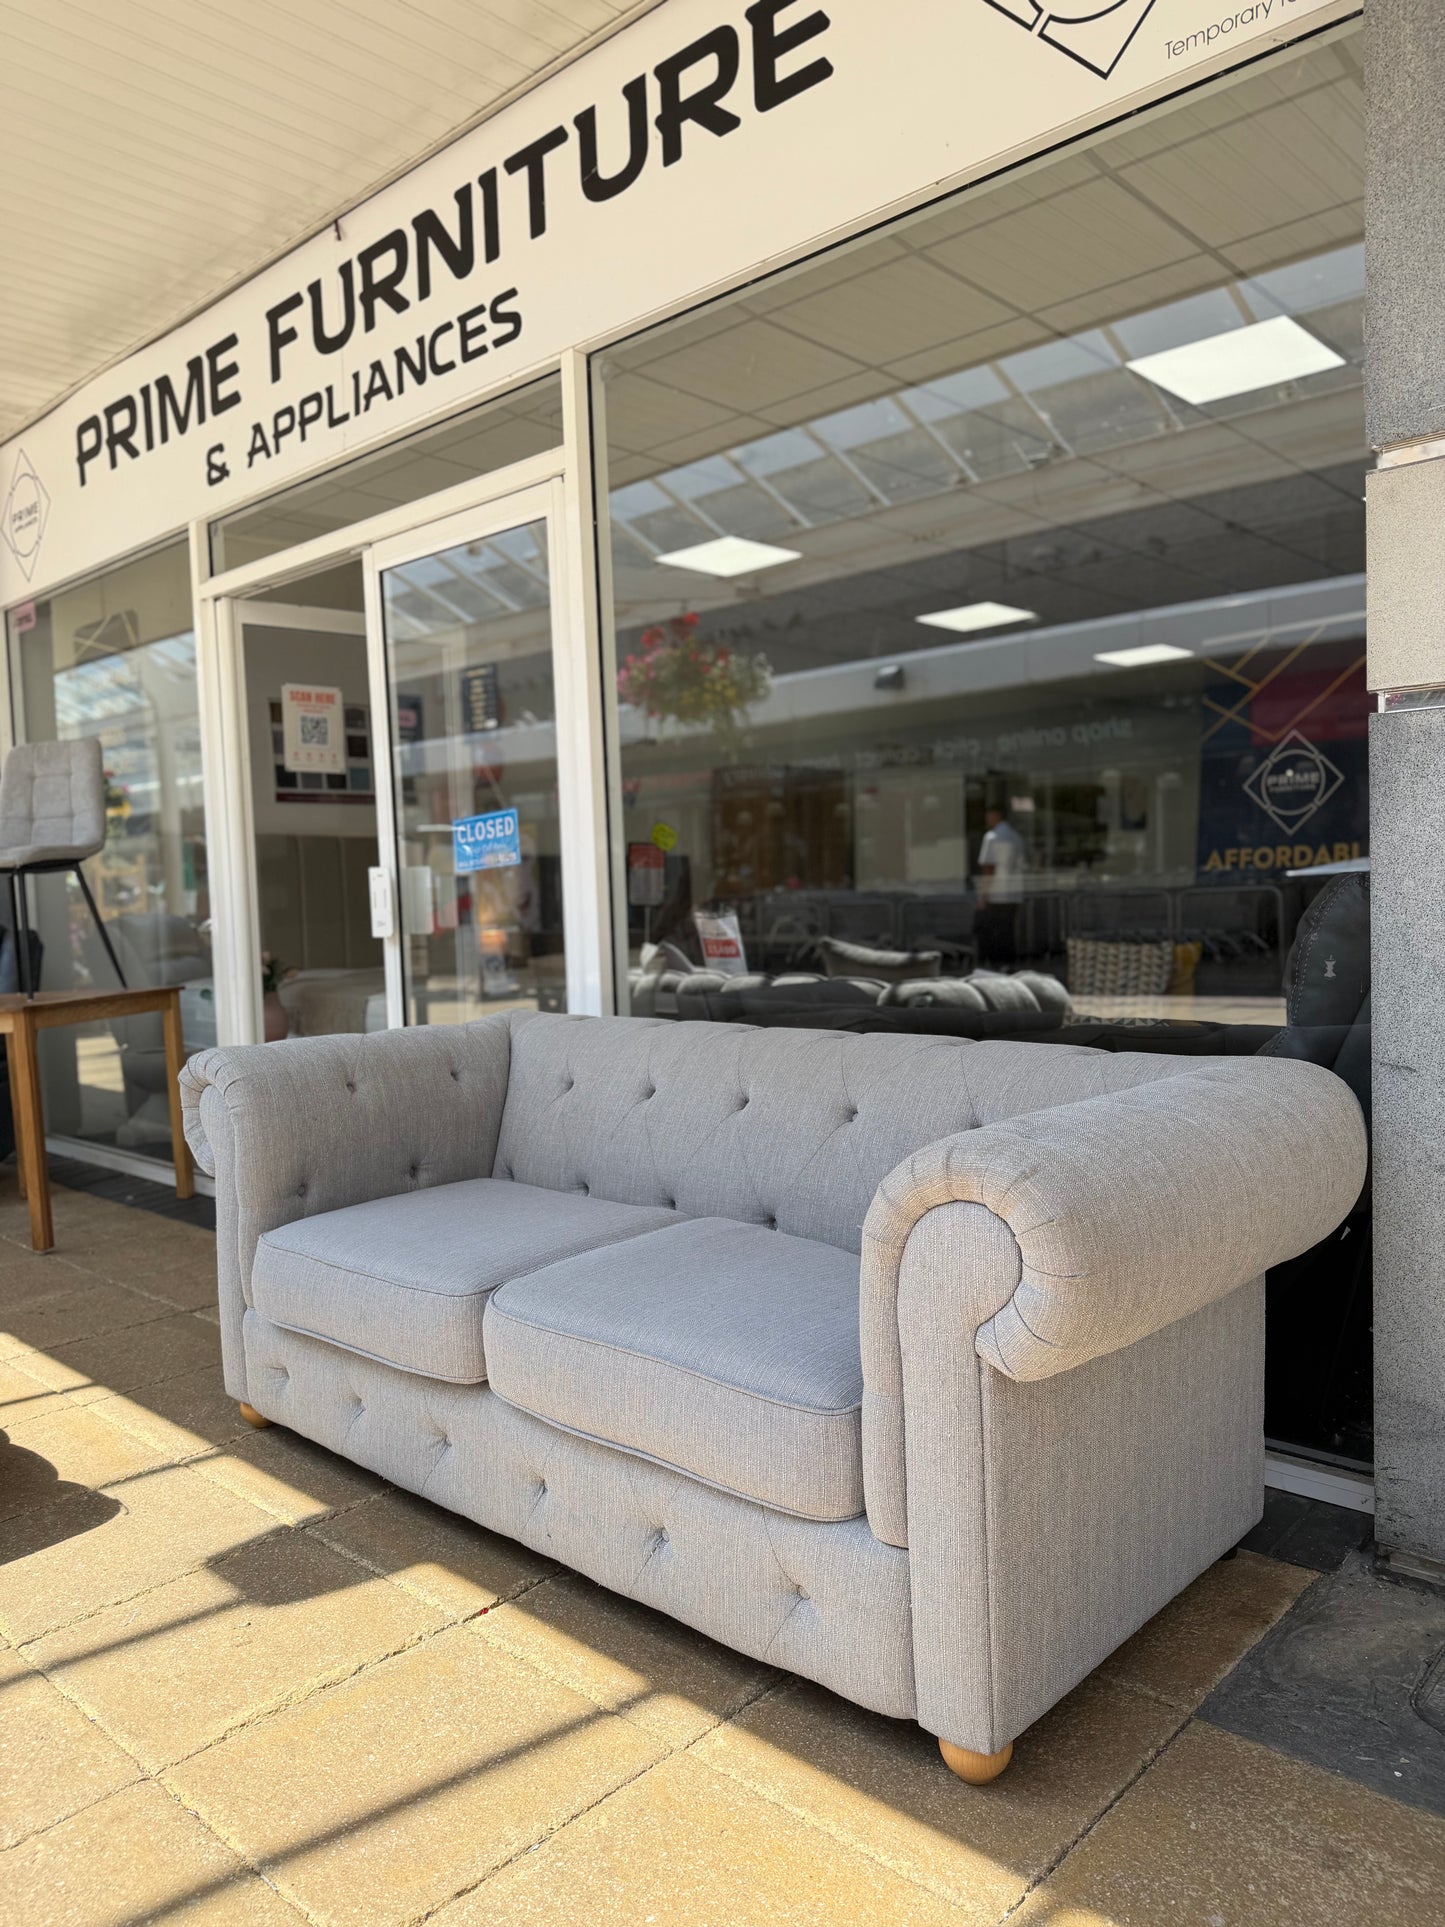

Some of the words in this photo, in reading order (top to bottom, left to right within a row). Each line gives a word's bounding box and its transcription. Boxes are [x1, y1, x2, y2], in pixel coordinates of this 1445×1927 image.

[1164, 0, 1273, 59] Temporary
[75, 332, 242, 488] PRIME
[265, 0, 835, 385] FURNITURE
[205, 443, 230, 486] &
[247, 287, 523, 469] APPLIANCES
[289, 690, 312, 702] SCAN
[315, 691, 336, 705] HERE
[1267, 771, 1320, 786] PRIME
[457, 816, 515, 844] CLOSED
